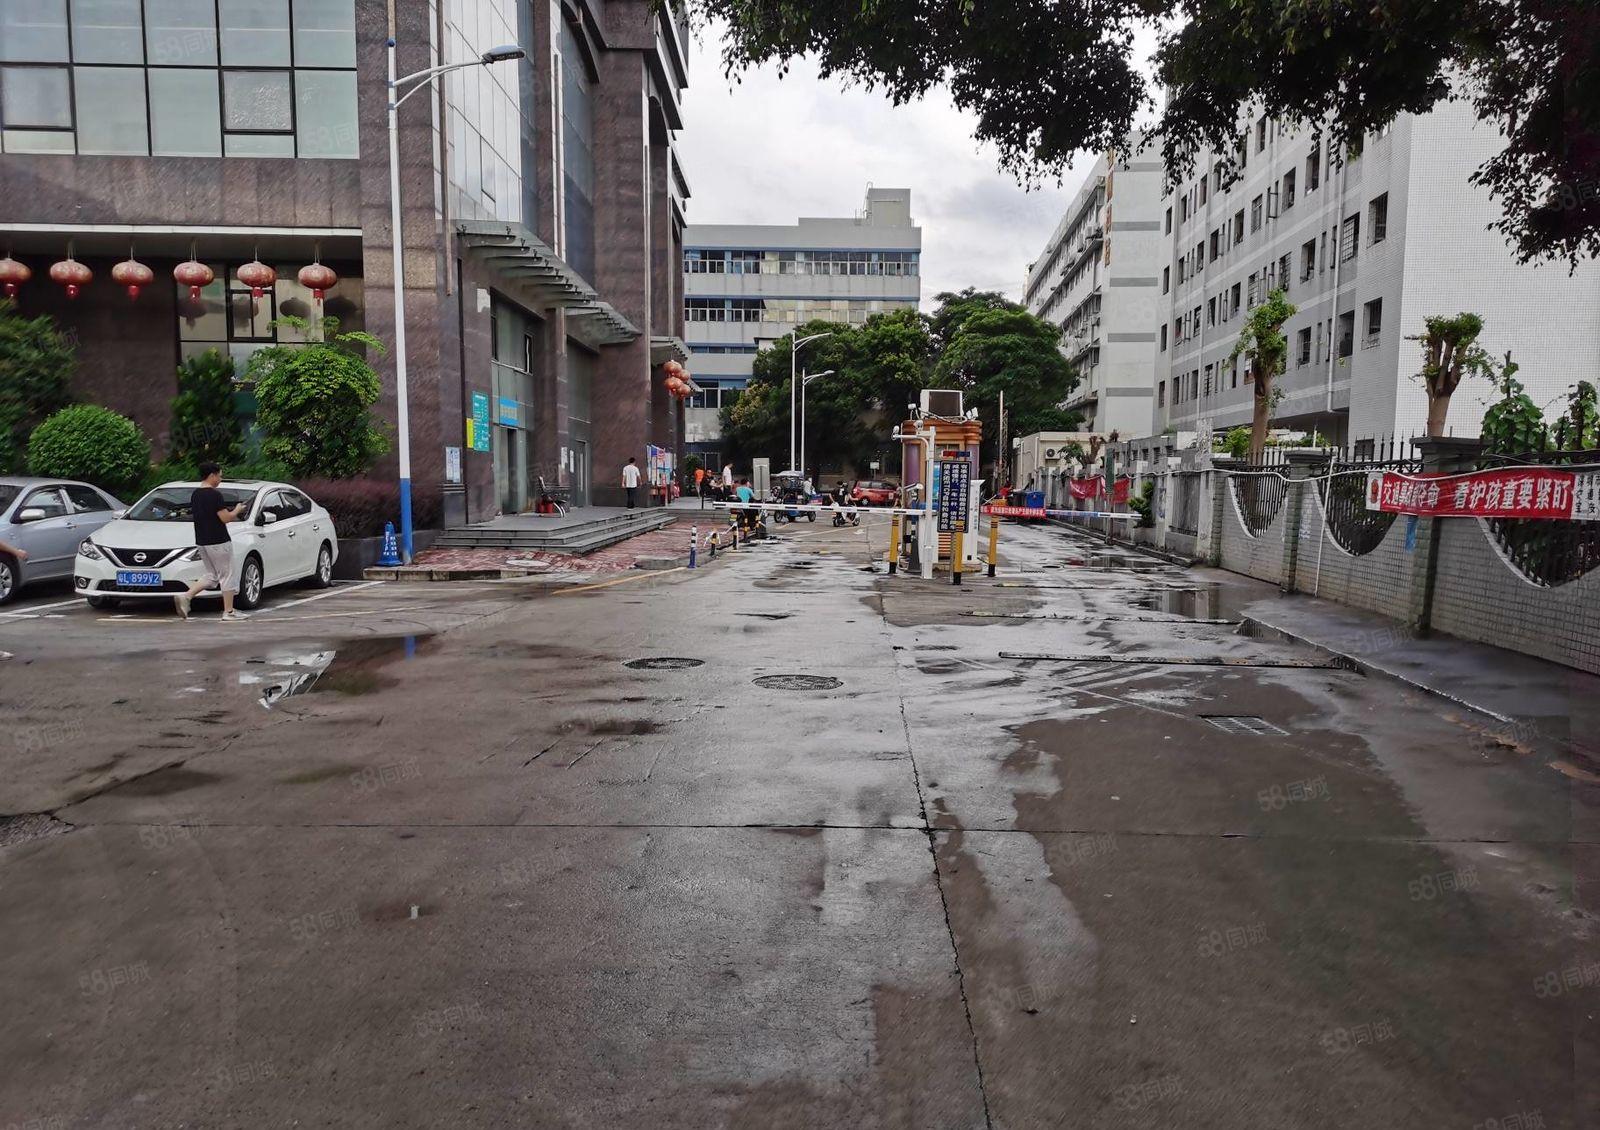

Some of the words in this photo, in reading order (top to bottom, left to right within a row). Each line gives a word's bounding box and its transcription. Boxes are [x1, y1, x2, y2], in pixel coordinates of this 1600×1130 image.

[1453, 477, 1571, 511] 看护孩童要紧盯
